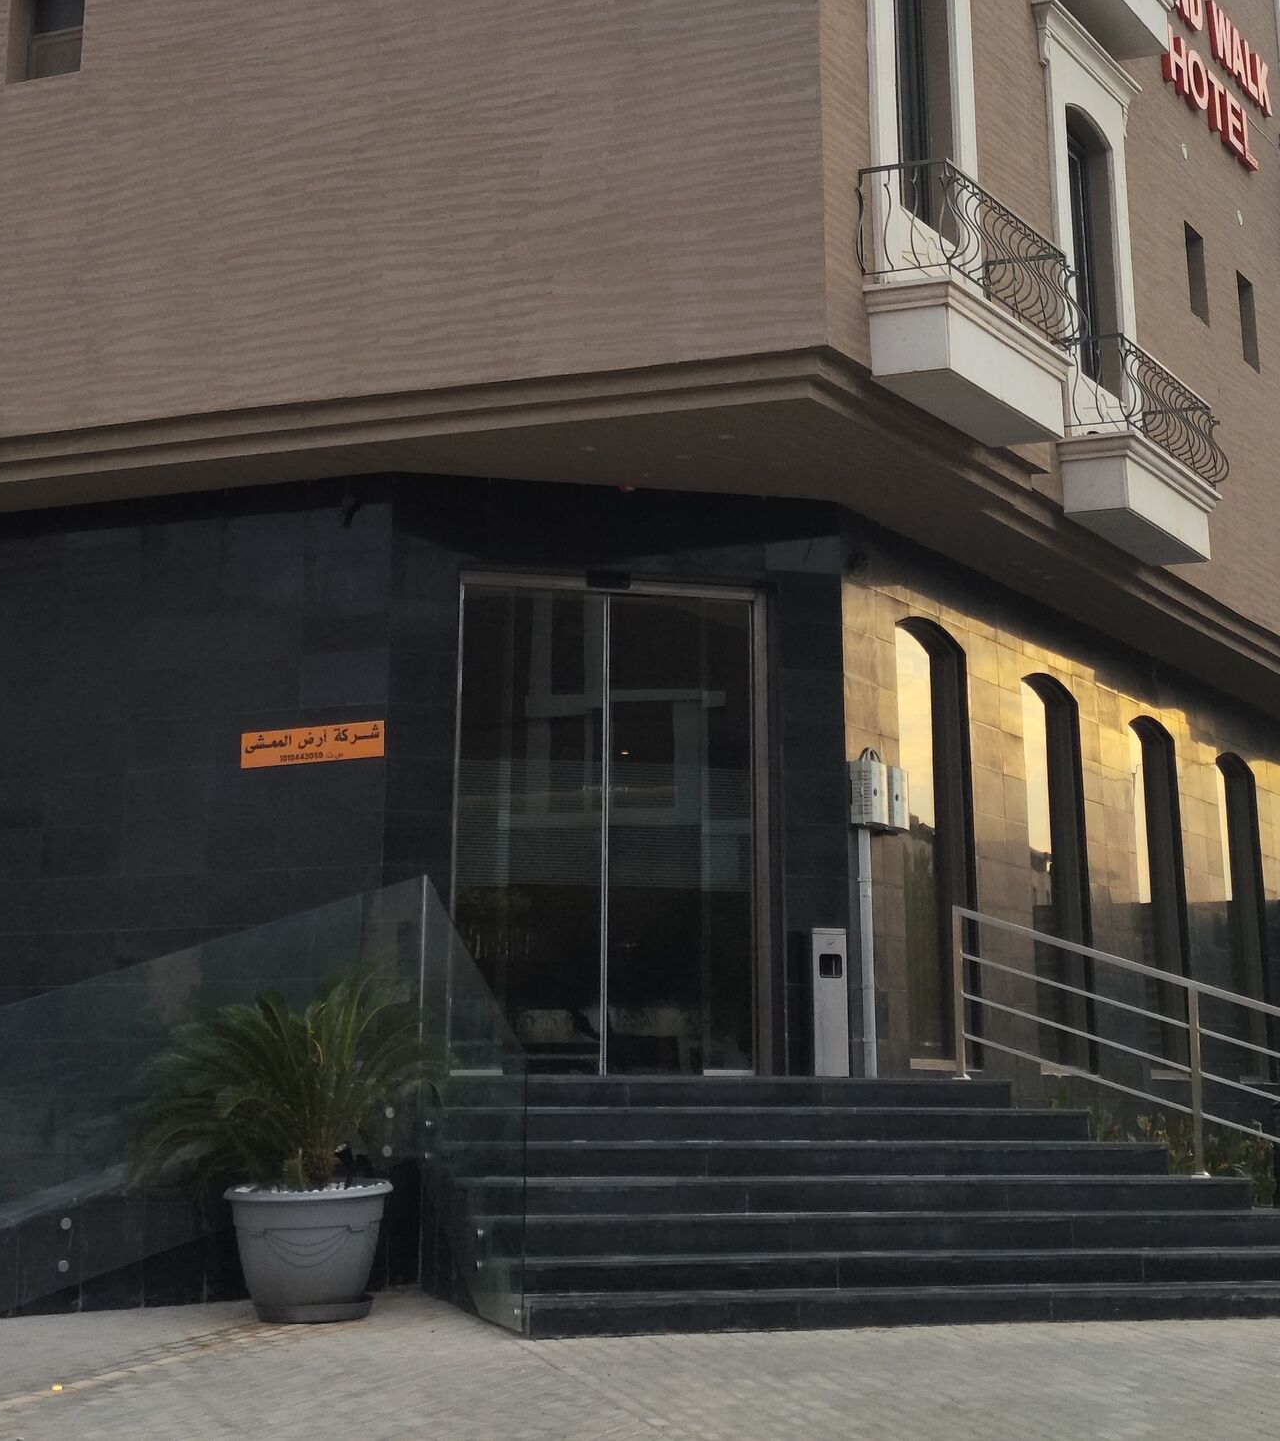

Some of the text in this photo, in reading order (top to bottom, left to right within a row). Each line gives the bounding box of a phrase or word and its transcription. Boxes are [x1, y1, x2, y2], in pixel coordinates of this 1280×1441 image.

[1161, 23, 1259, 172] HOTEL
[1205, 0, 1273, 118] WALK
[334, 724, 380, 745] شركة
